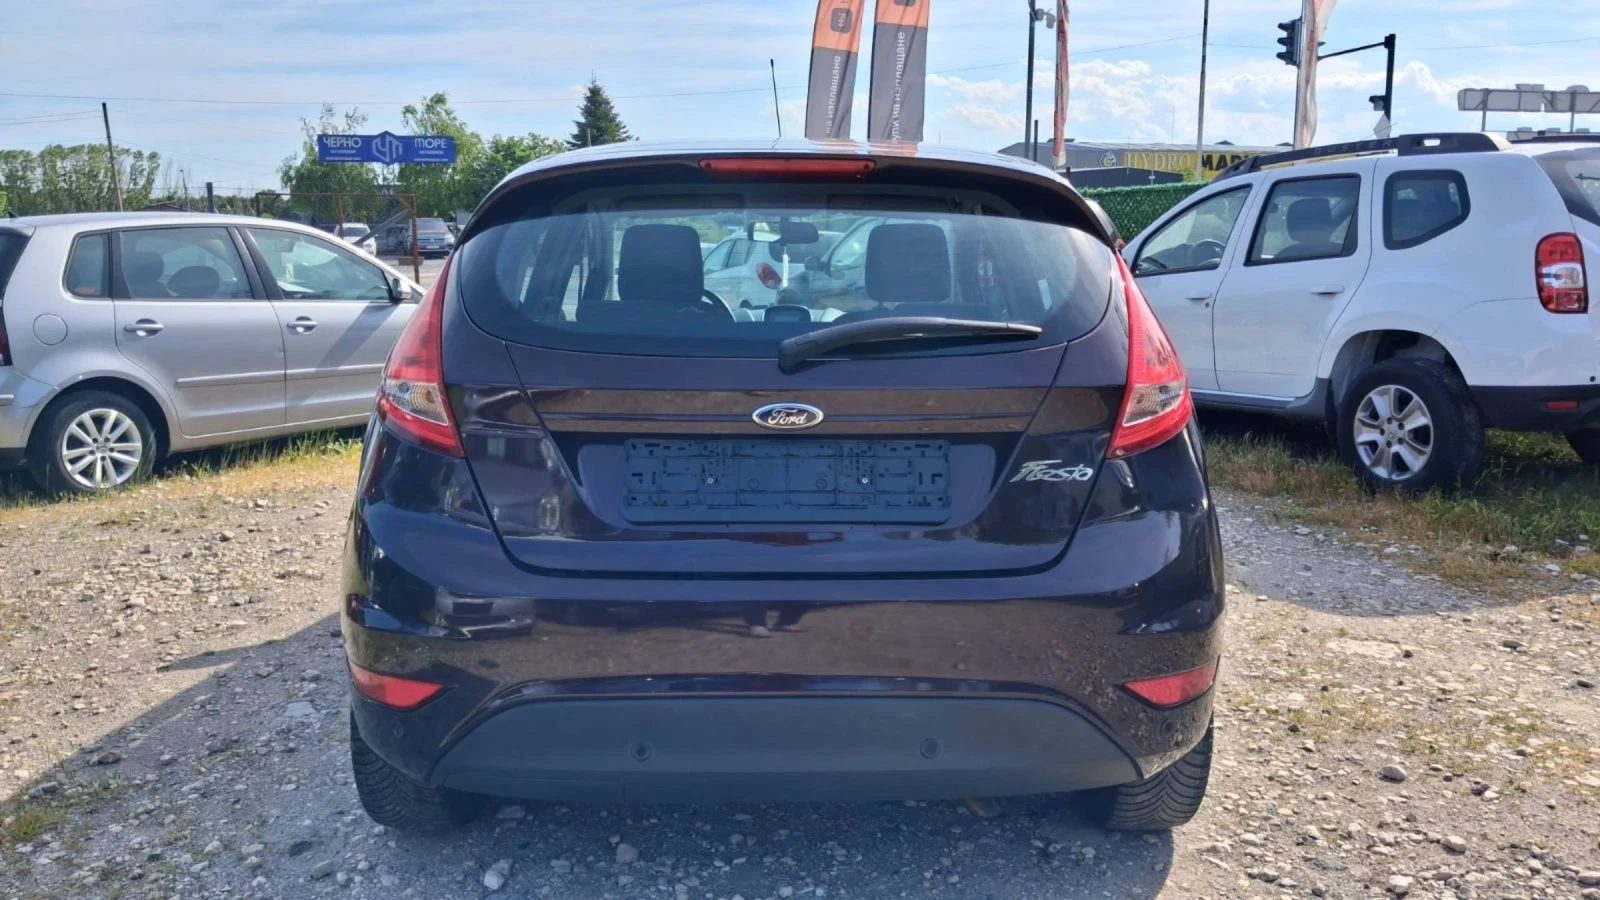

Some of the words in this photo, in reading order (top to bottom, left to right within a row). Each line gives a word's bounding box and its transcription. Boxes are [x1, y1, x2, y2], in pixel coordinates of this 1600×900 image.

[894, 31, 906, 101] изплащане
[828, 55, 841, 118] изплащане
[892, 104, 901, 118] на
[322, 136, 362, 148] ЧЕРНО
[414, 138, 447, 149] МОРЕ
[1314, 139, 1393, 154] DUSTER
[1127, 152, 1192, 170] HYDRO
[767, 408, 808, 425] Ford
[1009, 459, 1094, 483] Fiesta
